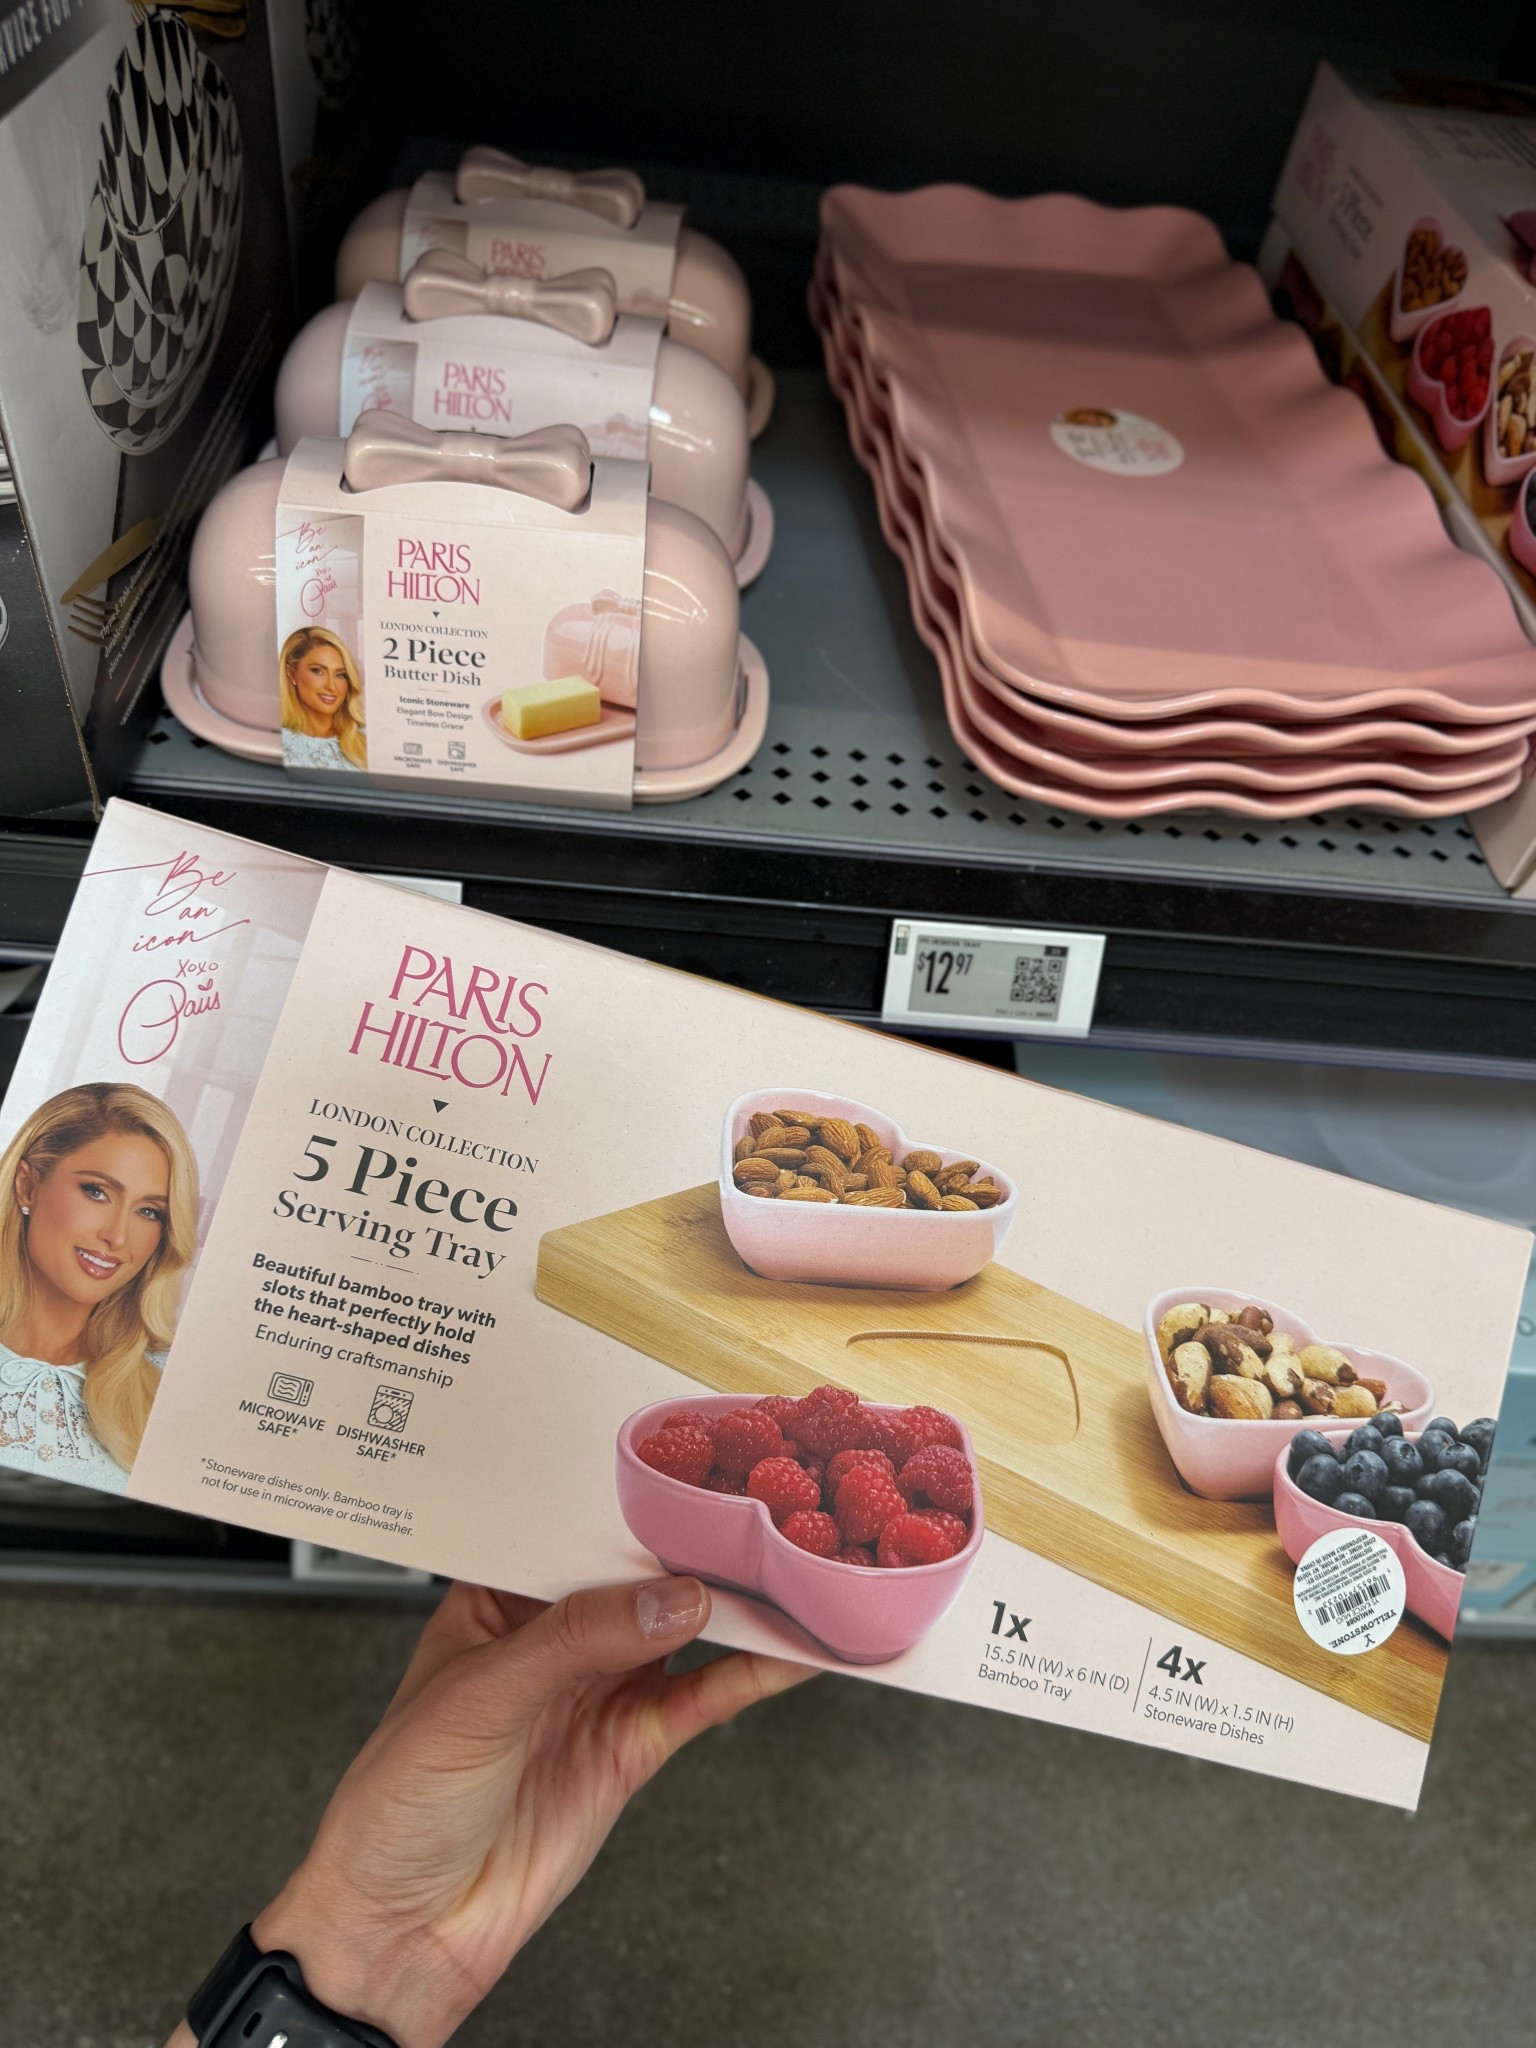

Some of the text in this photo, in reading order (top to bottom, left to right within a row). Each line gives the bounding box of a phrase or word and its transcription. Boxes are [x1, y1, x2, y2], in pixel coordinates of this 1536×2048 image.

[491, 238, 546, 276] PARIS
[443, 361, 506, 395] PARIS
[433, 388, 513, 423] HILTON
[276, 521, 327, 554] Be
[398, 538, 471, 574] PARIS
[388, 570, 480, 606] HILTON
[380, 621, 487, 638] LONDON COLLECTION
[382, 637, 485, 668] 2 Piece
[384, 664, 480, 686] Butter Dish
[396, 705, 473, 721] Elegant Bow Design
[399, 695, 470, 709] Iconic Stoneware
[405, 717, 464, 730] Timeless Grace
[83, 851, 237, 917] Be
[179, 906, 218, 920] an
[132, 919, 251, 953] icon
[388, 944, 548, 1037] PARIS
[118, 979, 222, 1066] Paris
[348, 1001, 552, 1105] HILTON
[308, 1098, 539, 1173] LONDON COLLECTION
[292, 1134, 517, 1232] 5 Piece
[272, 1189, 506, 1279] Serving Tray
[252, 1252, 495, 1328] Beautiful bamboo tray with
[261, 1279, 475, 1343] slots that perfectly hold
[254, 1297, 470, 1364] the heart-shaped dishes
[255, 1323, 453, 1389] Enduring craftsmanship
[238, 1399, 425, 1456] MICROWAVE DISHWASHER
[200, 1476, 412, 1536] not for use in microwave or dishwasher.
[266, 1475, 303, 1492] dishes
[304, 1486, 329, 1500] only.
[332, 1490, 380, 1511] Bamboo
[382, 1503, 403, 1519] tray
[403, 1508, 413, 1519] is
[991, 1600, 1207, 1685] 1x 4x
[978, 1663, 1072, 1701] Bamboo Tray
[985, 1643, 1129, 1693] 15.5 IN (W) x 6 IN (D)
[1143, 1703, 1264, 1744] Stoneware Dishes
[1148, 1684, 1293, 1733] 4.5 IN (W) x 1.5 IN (H)
